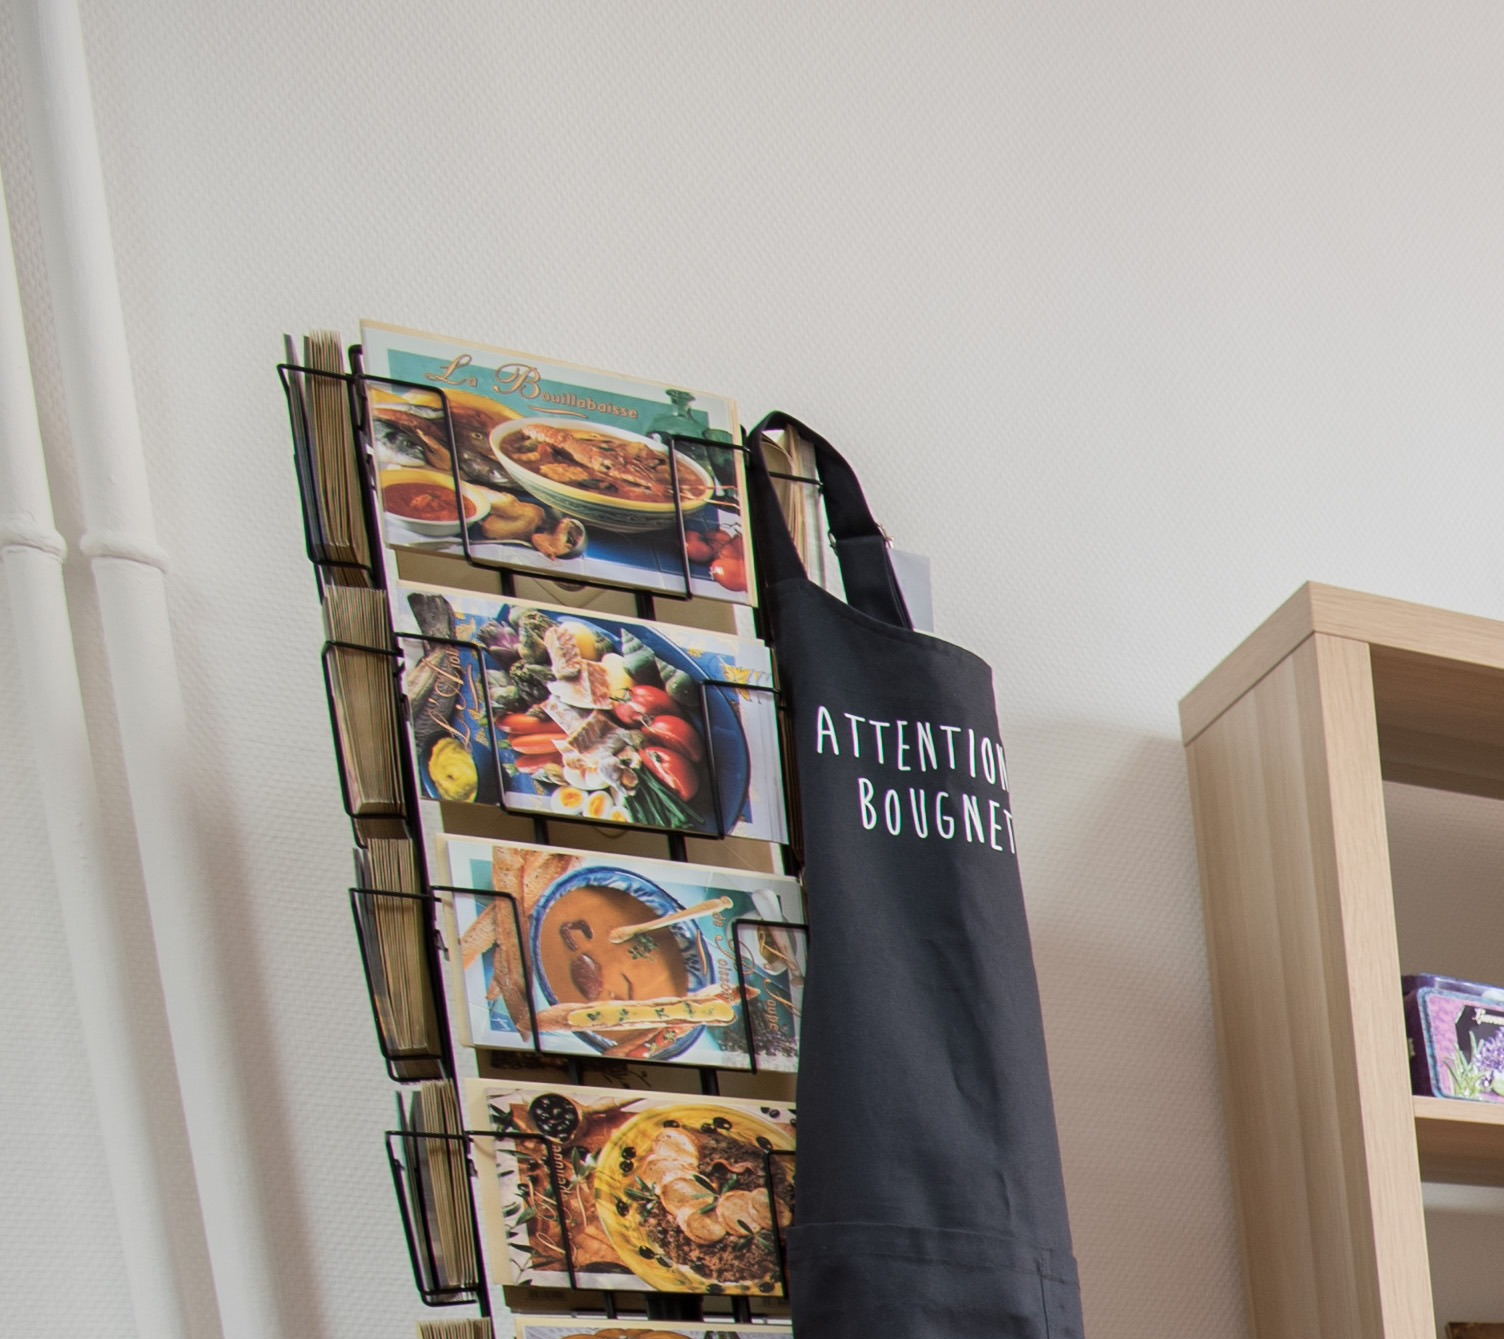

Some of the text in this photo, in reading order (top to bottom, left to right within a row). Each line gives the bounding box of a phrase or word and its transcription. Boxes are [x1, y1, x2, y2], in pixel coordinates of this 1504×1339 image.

[424, 354, 638, 418] La Bouillabaisse
[816, 705, 1008, 791] ATTENTION
